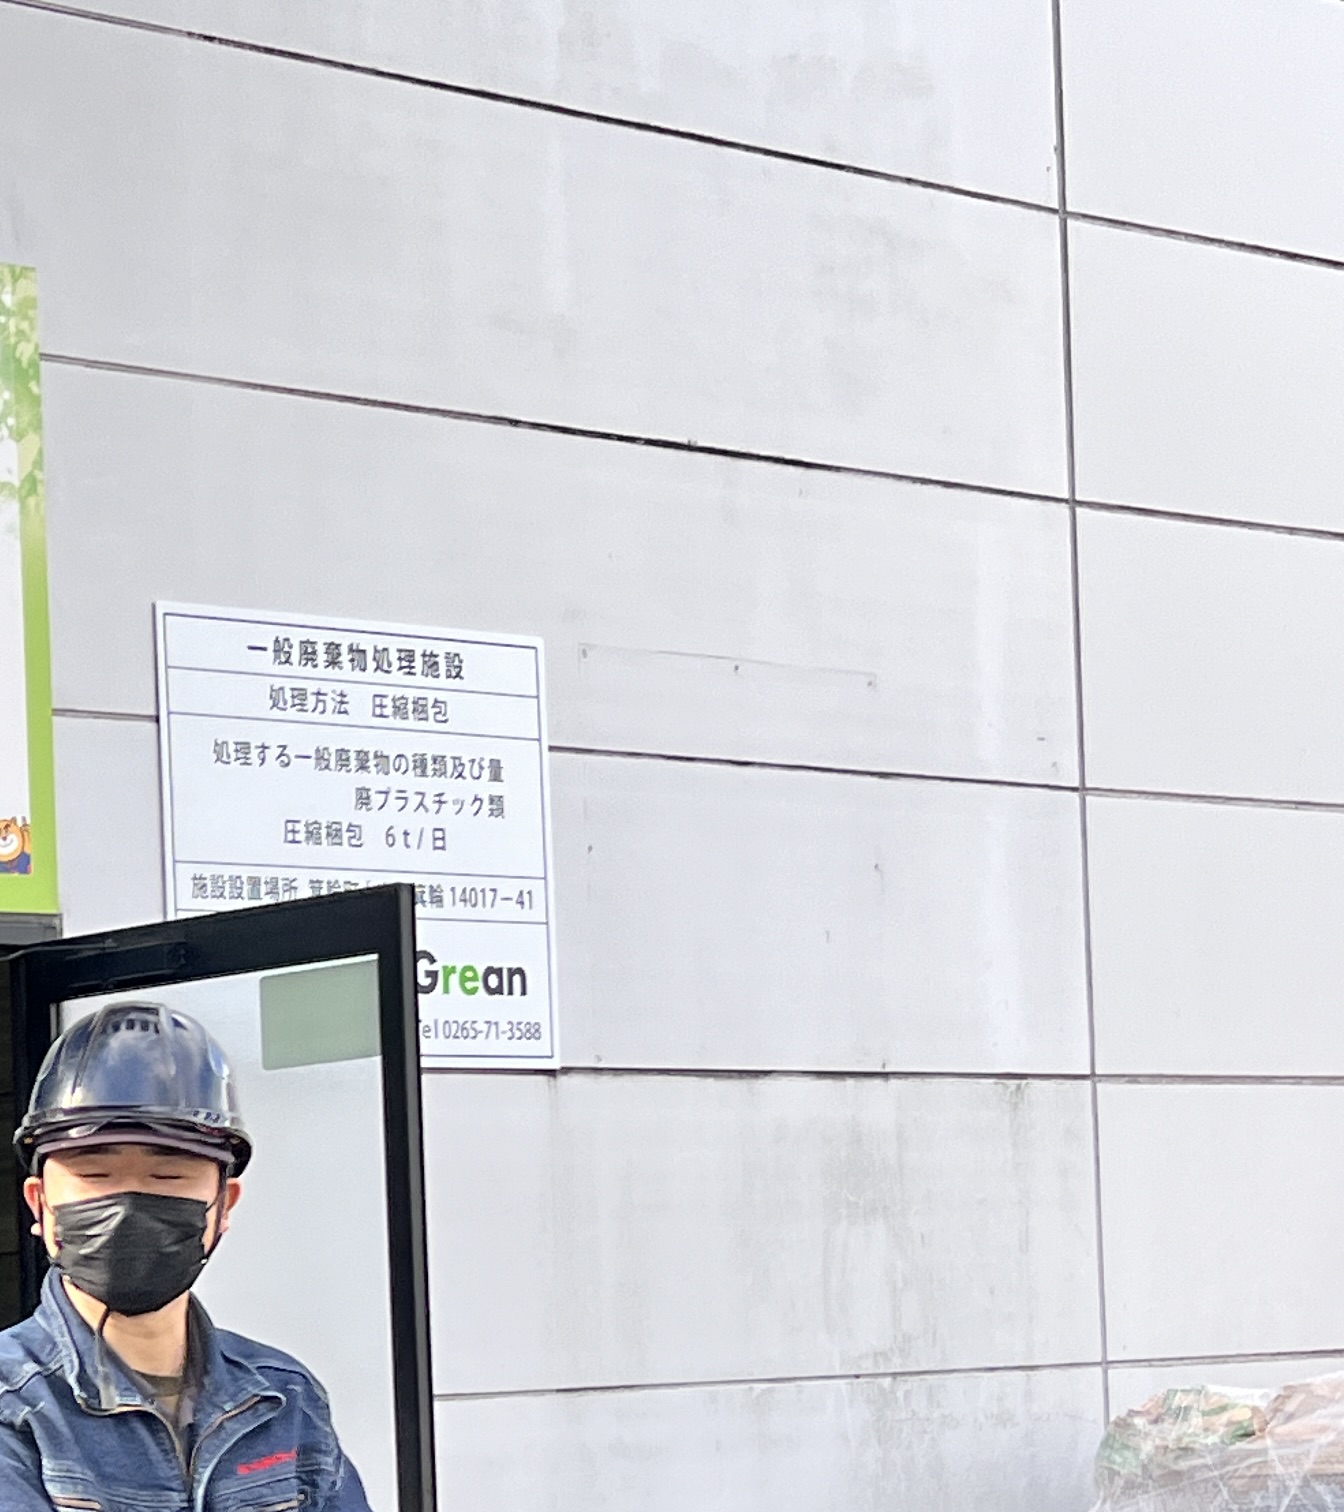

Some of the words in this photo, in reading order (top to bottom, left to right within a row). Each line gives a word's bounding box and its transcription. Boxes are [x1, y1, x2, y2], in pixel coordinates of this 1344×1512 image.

[247, 636, 465, 681] 一般廃棄物処理施設
[268, 684, 350, 718] 処理方法
[370, 693, 450, 724] 圧縮梱包
[212, 738, 504, 783] 処理する一般廃棄物の種類及び量
[353, 786, 505, 820] 廃プラスチック類
[283, 819, 365, 849] 圧縮梱包
[191, 872, 299, 901] 施設設置場所
